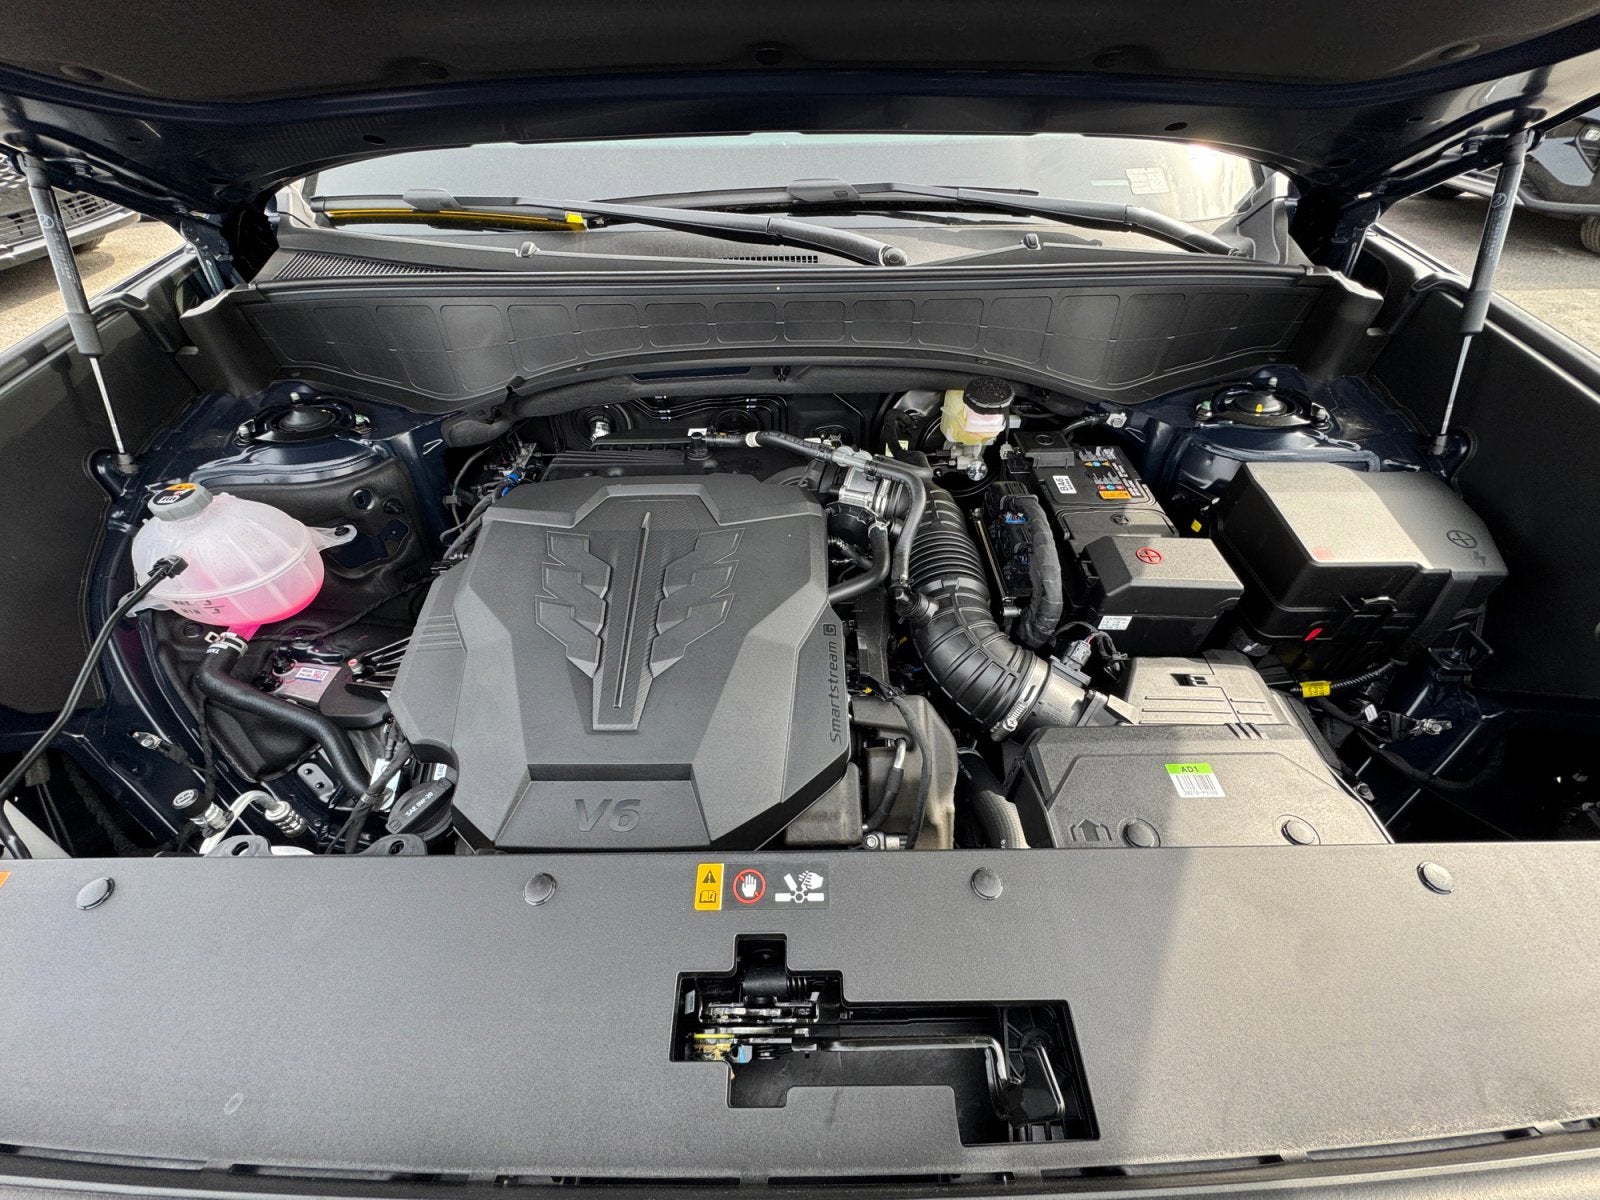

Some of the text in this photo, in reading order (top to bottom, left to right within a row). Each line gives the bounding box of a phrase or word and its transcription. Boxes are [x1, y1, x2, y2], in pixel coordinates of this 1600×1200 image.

[827, 641, 842, 745] Smartstream
[405, 806, 418, 817] SAE
[575, 798, 641, 832] V6
